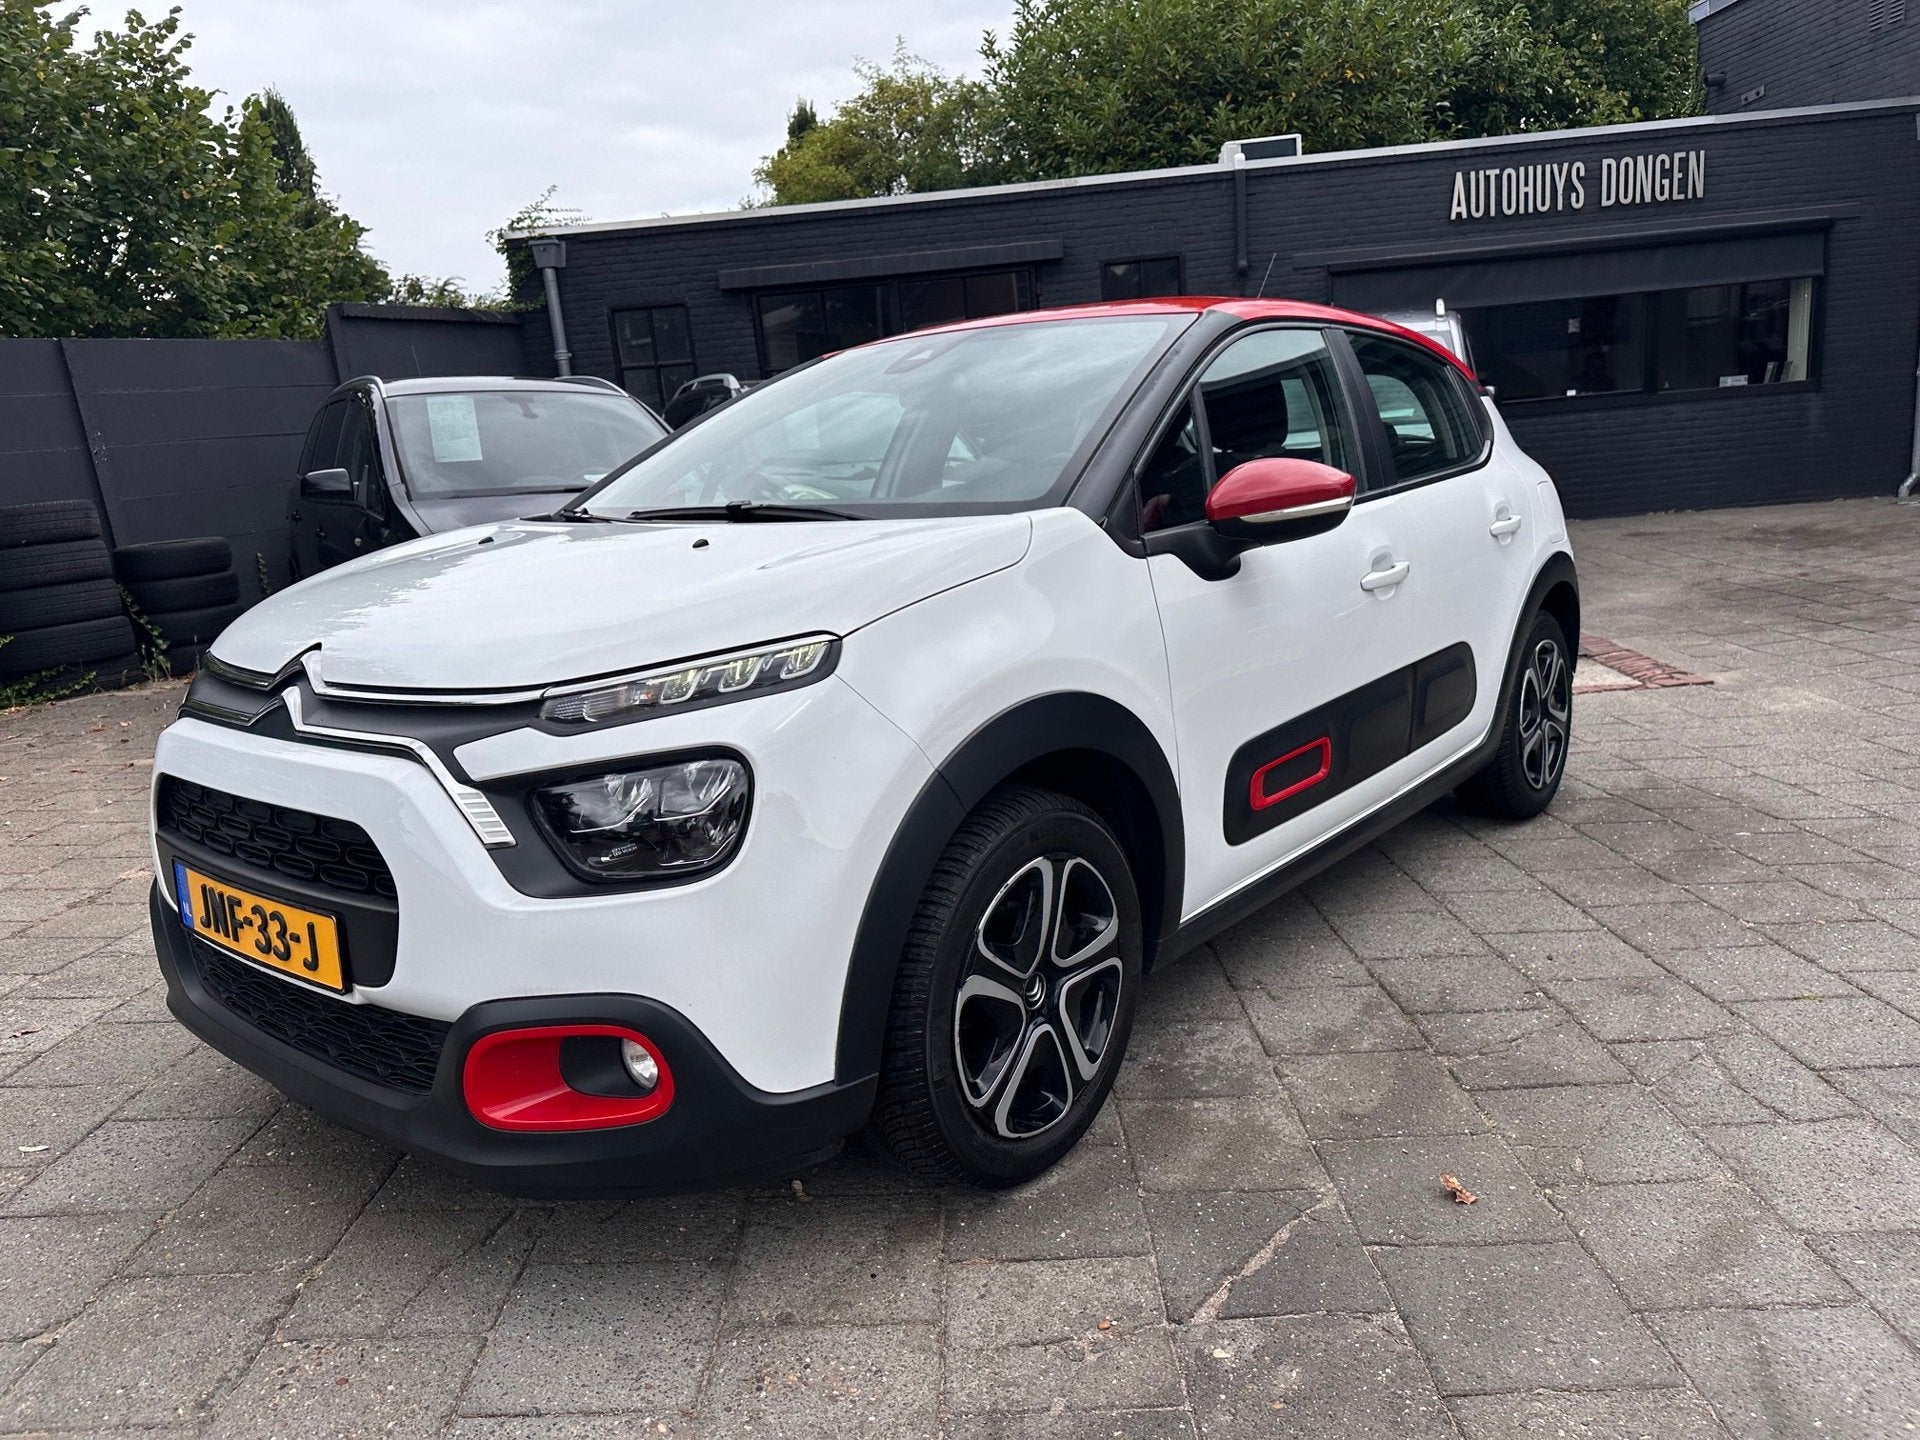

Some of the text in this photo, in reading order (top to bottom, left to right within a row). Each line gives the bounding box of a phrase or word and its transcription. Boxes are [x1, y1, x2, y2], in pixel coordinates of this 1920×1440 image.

[1450, 150, 1705, 220] AUTOHUYS DONGEN
[200, 883, 319, 972] JNF-33-J
